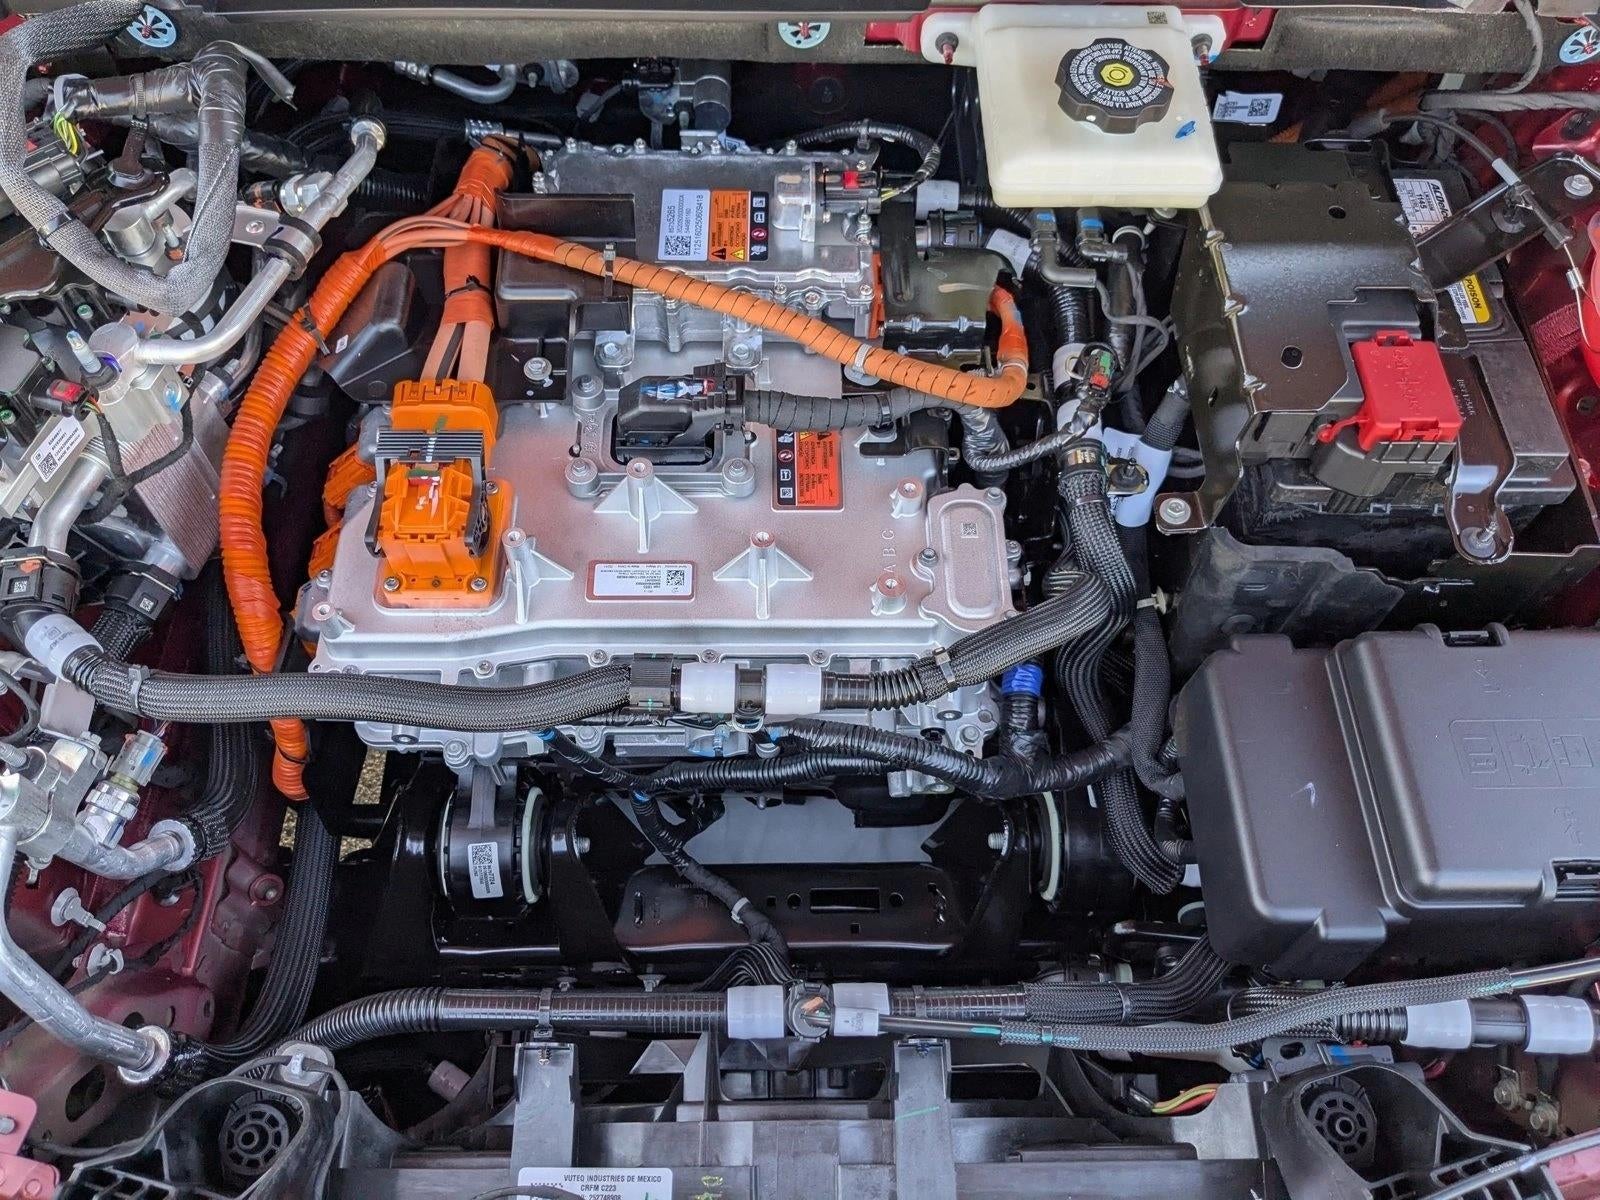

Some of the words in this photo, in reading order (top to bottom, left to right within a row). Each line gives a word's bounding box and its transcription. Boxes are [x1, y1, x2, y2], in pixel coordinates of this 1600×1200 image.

[1430, 181, 1451, 221] ACDelc
[1465, 278, 1482, 309] POISON
[882, 530, 895, 540] C
[883, 548, 896, 556] B
[883, 564, 896, 573] A
